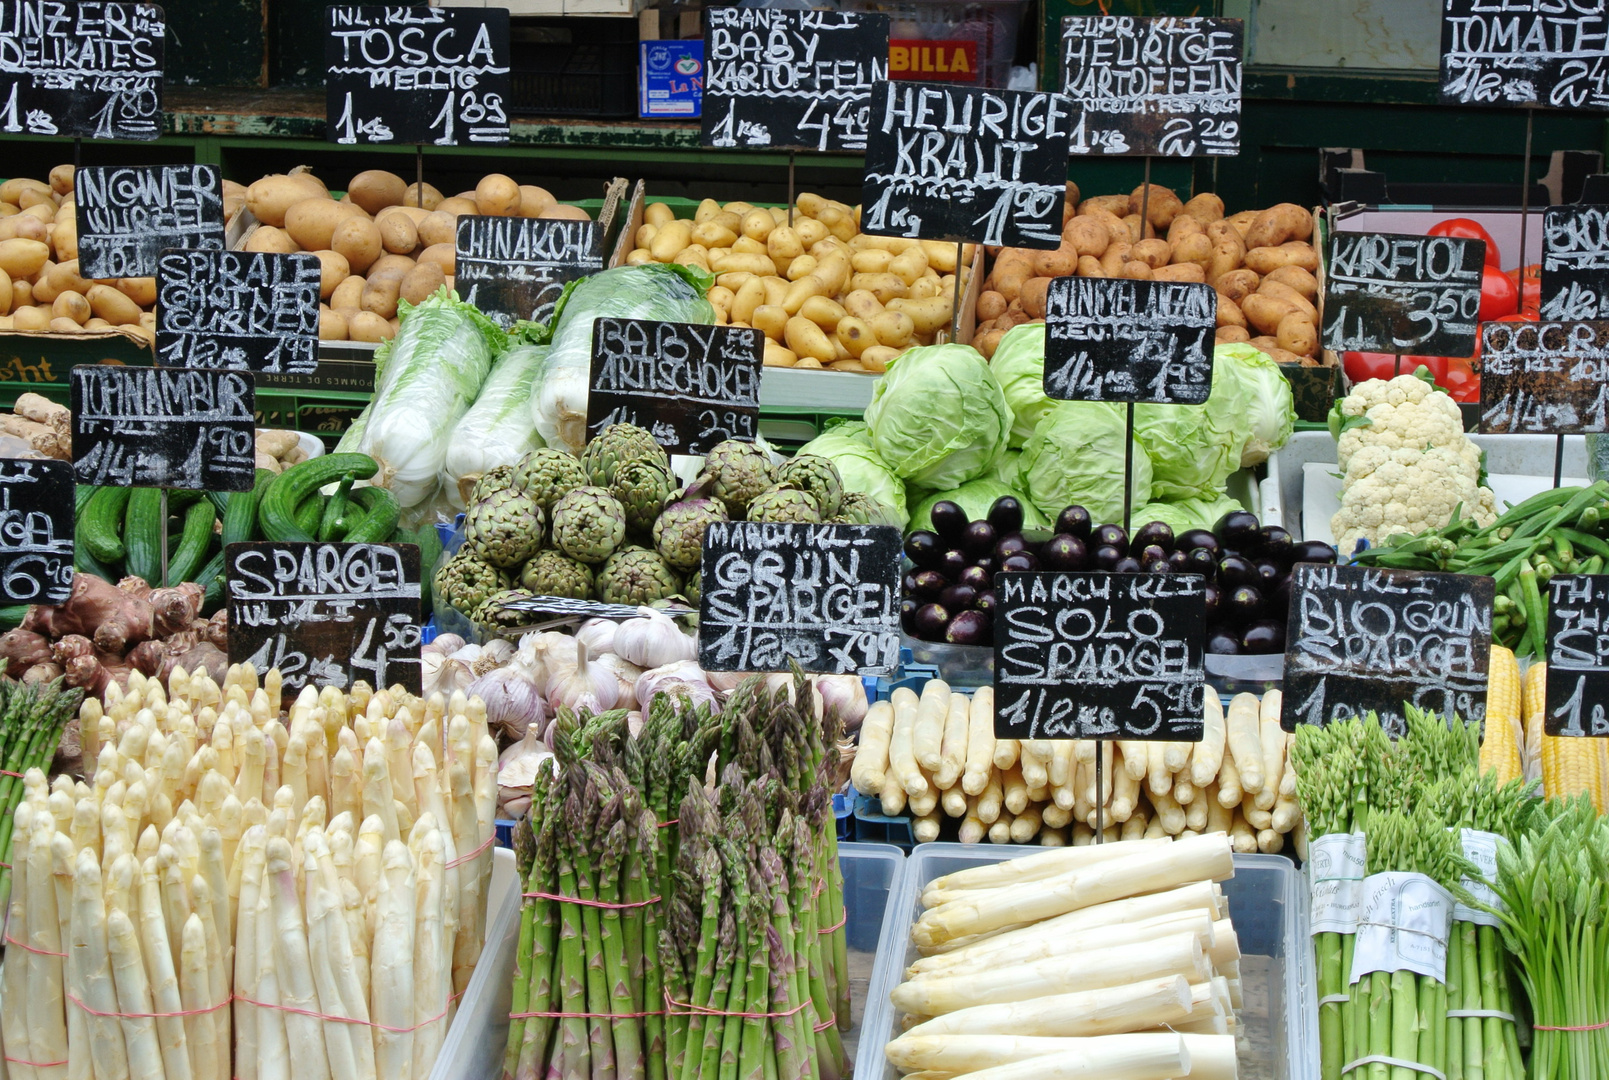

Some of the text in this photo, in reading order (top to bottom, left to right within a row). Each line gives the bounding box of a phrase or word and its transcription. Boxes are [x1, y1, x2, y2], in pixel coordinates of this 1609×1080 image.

[0, 36, 156, 68] DELIKATES
[331, 22, 495, 65] TOSCA
[711, 28, 820, 65] BABY
[889, 46, 970, 73] BILLA
[1065, 32, 1237, 65] HEURIGE
[669, 80, 689, 94] La
[707, 56, 889, 90] KARTOFFELN
[1063, 61, 1243, 98] KARTOFFELN
[882, 82, 1073, 139] HEURIGE
[893, 127, 1039, 181] KRAUT
[76, 165, 222, 208] INGWER
[87, 205, 223, 233] WURZEL
[456, 218, 603, 262] CHINAKOHL
[159, 252, 321, 288] SPIRALE
[1330, 234, 1478, 281] KARFIOL
[163, 307, 320, 334] GURKEN
[598, 318, 717, 363] BABY
[73, 368, 254, 416] TOPINAMBUR
[266, 374, 373, 387] POMMES DE TERRE
[596, 355, 762, 400] ARTISCHOKEN
[230, 544, 421, 597] SPARGEL
[1298, 567, 1358, 590] INL.
[706, 583, 899, 625] SPARGEL
[1005, 605, 1165, 642] SOLO
[1301, 590, 1396, 641] BIO
[1001, 638, 1204, 681] SPARGEL
[1295, 632, 1488, 682] SPARGEL
